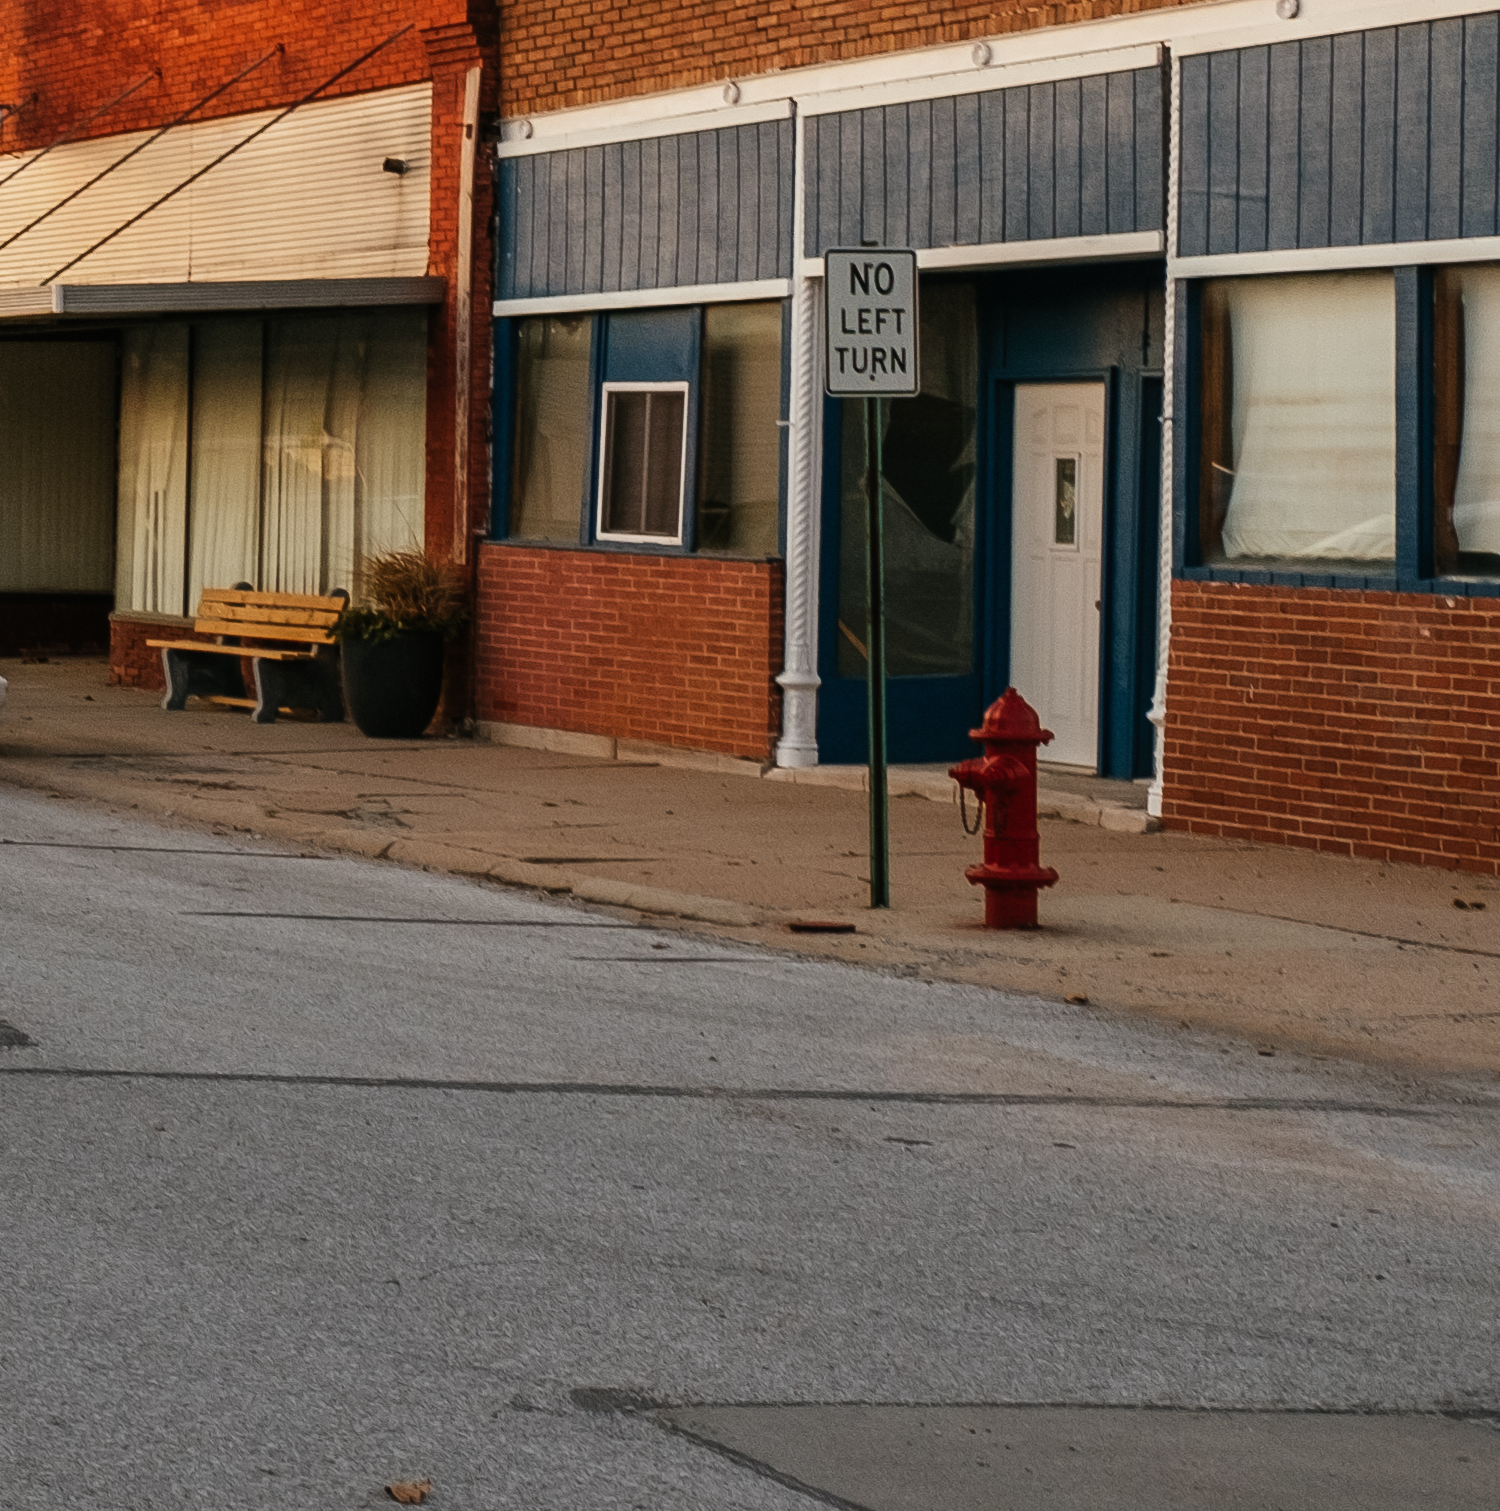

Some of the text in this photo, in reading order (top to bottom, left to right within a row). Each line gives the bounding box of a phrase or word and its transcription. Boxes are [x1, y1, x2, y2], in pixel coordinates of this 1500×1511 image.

[849, 261, 895, 296] NO
[840, 307, 907, 335] LEFT
[834, 346, 907, 375] TURN
